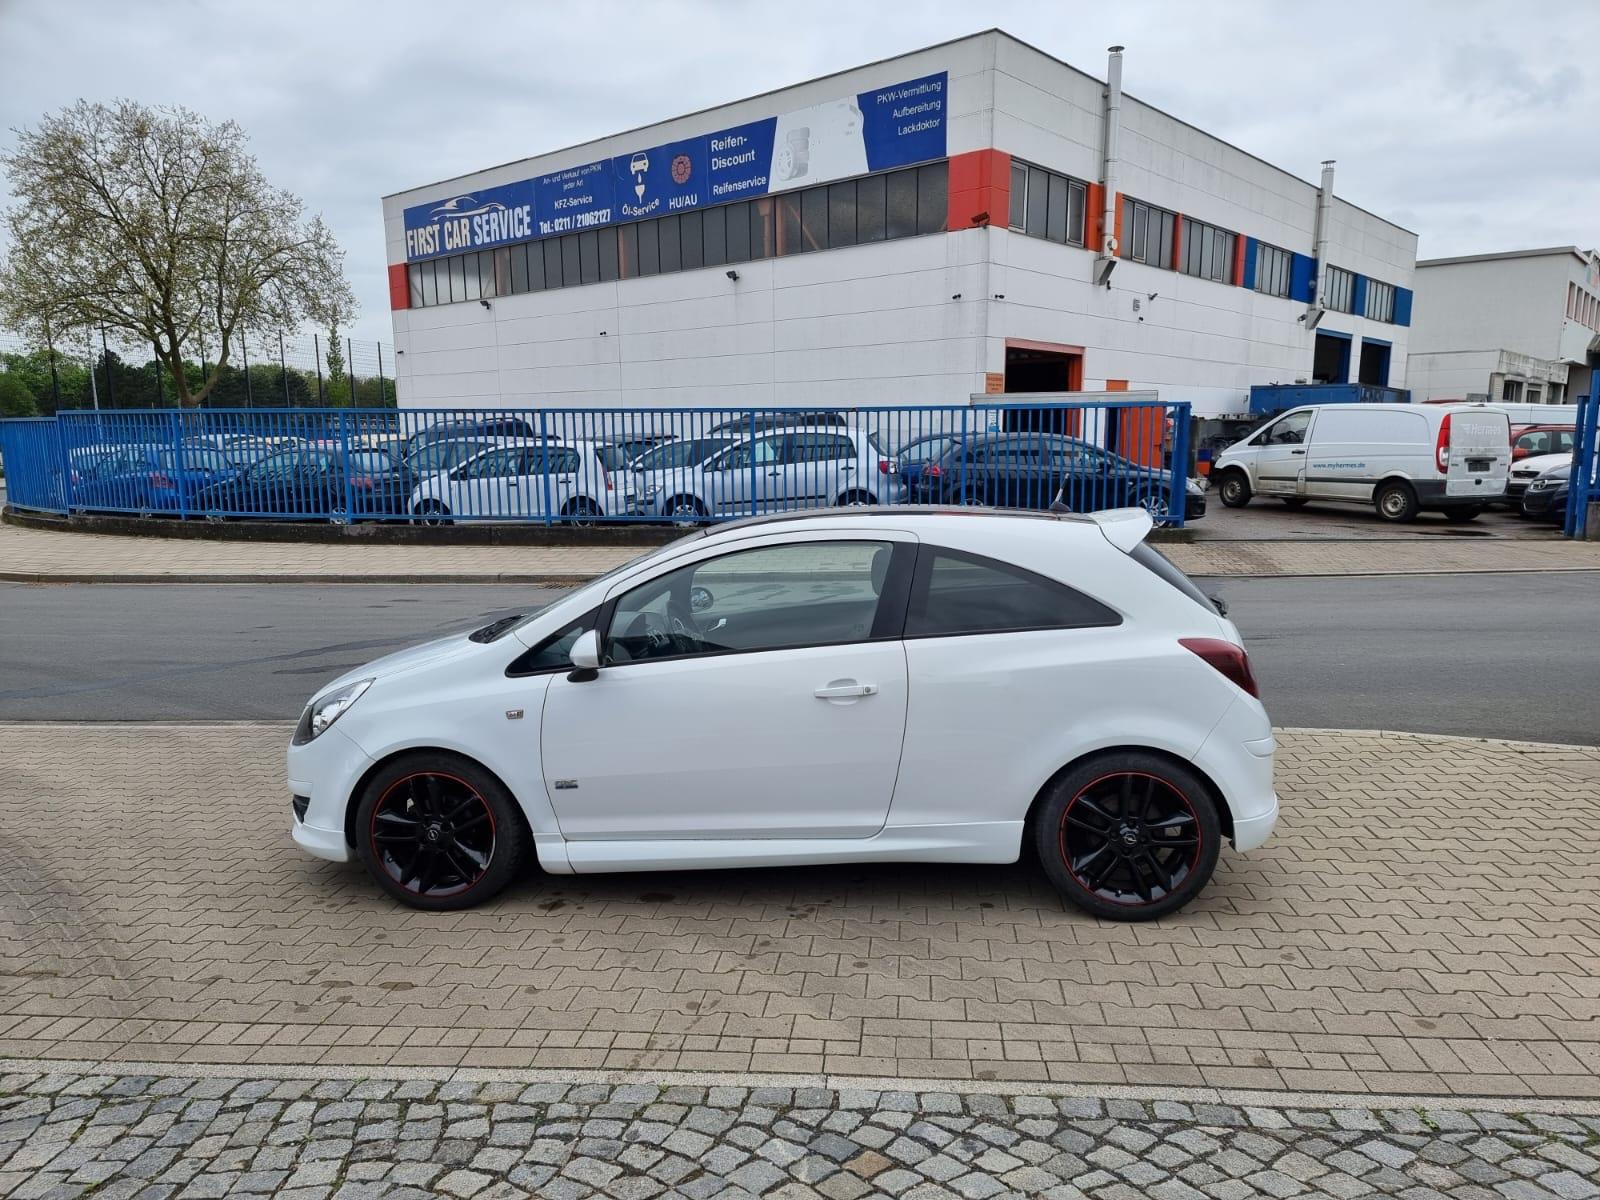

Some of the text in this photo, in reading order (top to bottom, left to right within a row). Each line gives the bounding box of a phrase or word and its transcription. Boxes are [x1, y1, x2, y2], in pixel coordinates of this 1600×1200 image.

[877, 81, 942, 105] PKW-Vermittlung
[893, 100, 941, 119] Aufbereitung
[898, 119, 940, 136] Lackdoktor
[711, 135, 748, 152] Reifen-
[711, 149, 756, 170] Discount
[713, 175, 767, 196] Reifenservice
[554, 195, 593, 210] KFZ-Service
[622, 198, 660, 216] Öl-Service
[669, 193, 698, 210] HU/AU
[406, 205, 532, 257] FIRST CAR SERVICE
[554, 216, 571, 232] 0211
[1313, 462, 1366, 470] www.myhermes.de
